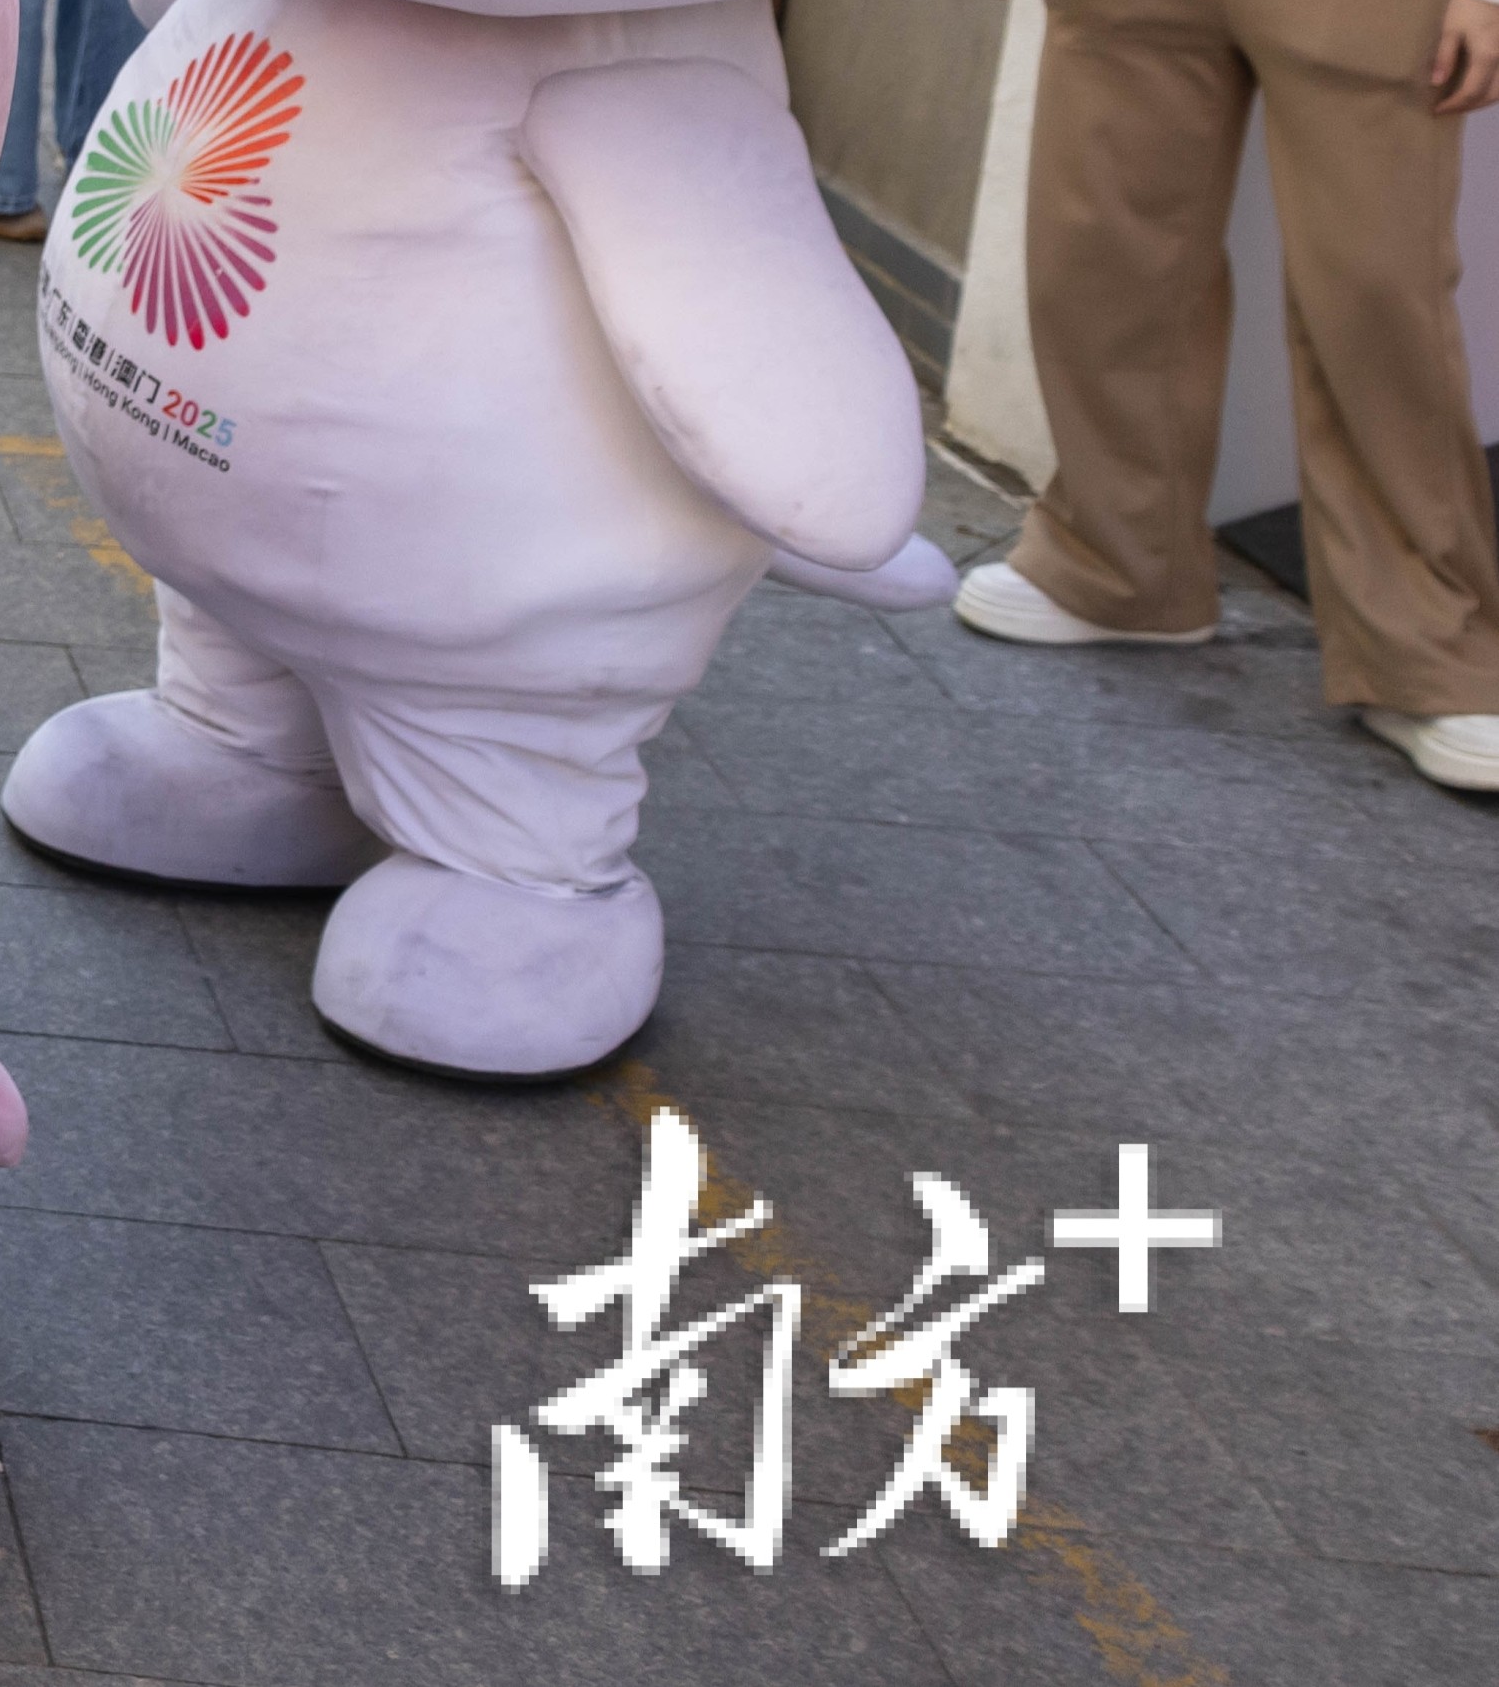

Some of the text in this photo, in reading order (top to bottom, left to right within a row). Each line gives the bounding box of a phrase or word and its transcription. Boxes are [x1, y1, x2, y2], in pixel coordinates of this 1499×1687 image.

[83, 369, 120, 408] Hong
[121, 395, 162, 436] Kong
[173, 429, 232, 473] Macao
[162, 389, 237, 447] 2025
